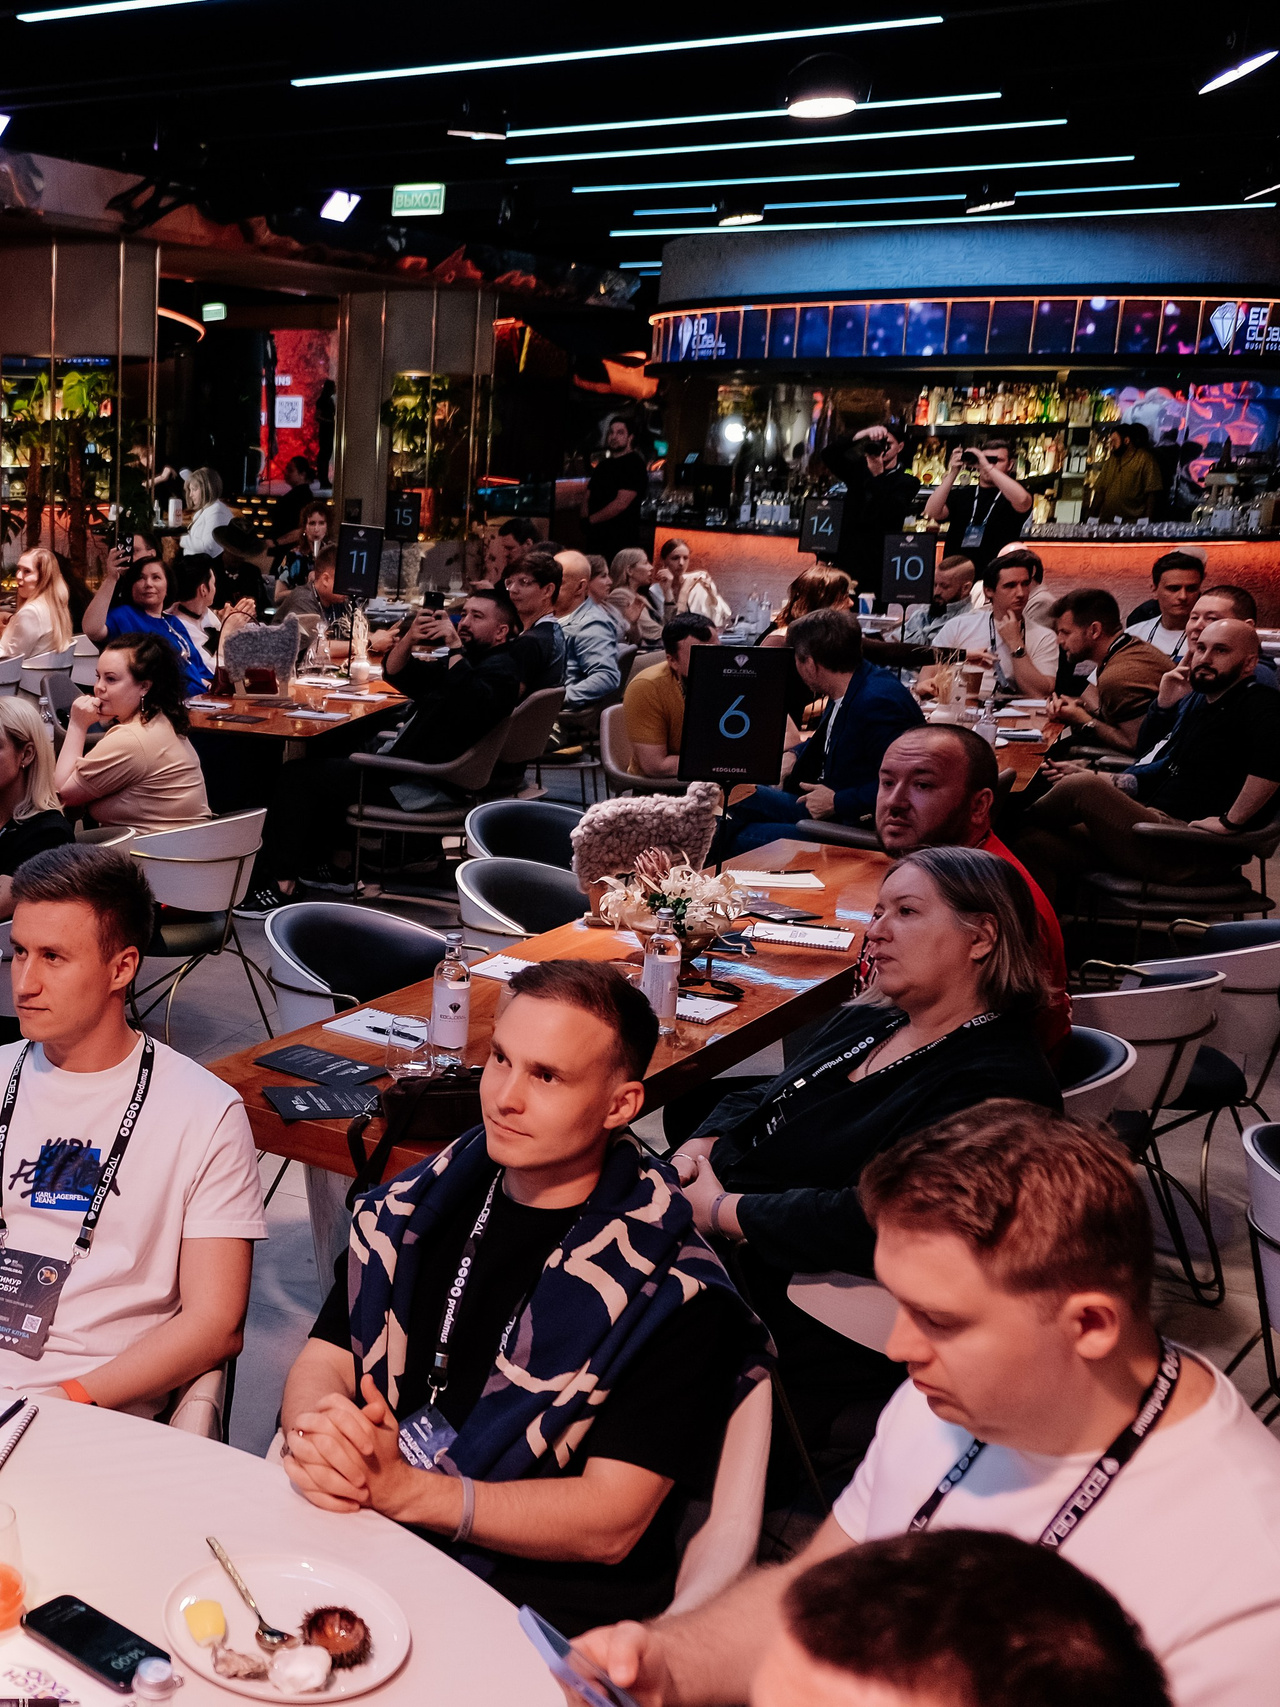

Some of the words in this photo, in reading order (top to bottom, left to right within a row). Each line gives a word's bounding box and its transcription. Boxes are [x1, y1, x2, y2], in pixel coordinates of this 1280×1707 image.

[395, 191, 440, 208] ВЫХОД
[394, 508, 413, 526] 15
[810, 516, 834, 536] 14
[349, 550, 368, 575] 11
[891, 555, 925, 581] 10
[719, 695, 750, 739] 6
[712, 766, 747, 774] #EDGLOBAL
[811, 1055, 844, 1077] prodamus
[135, 1068, 149, 1102] prodamus
[91, 1153, 121, 1212] EDGLOBAL
[11, 1329, 30, 1339] КЛУБА
[440, 1298, 457, 1344] prodamus
[1132, 1374, 1171, 1437] prodamus
[400, 1428, 433, 1470] ВЛАДИСЛАВ
[1041, 1466, 1110, 1547] EDGLOBA
